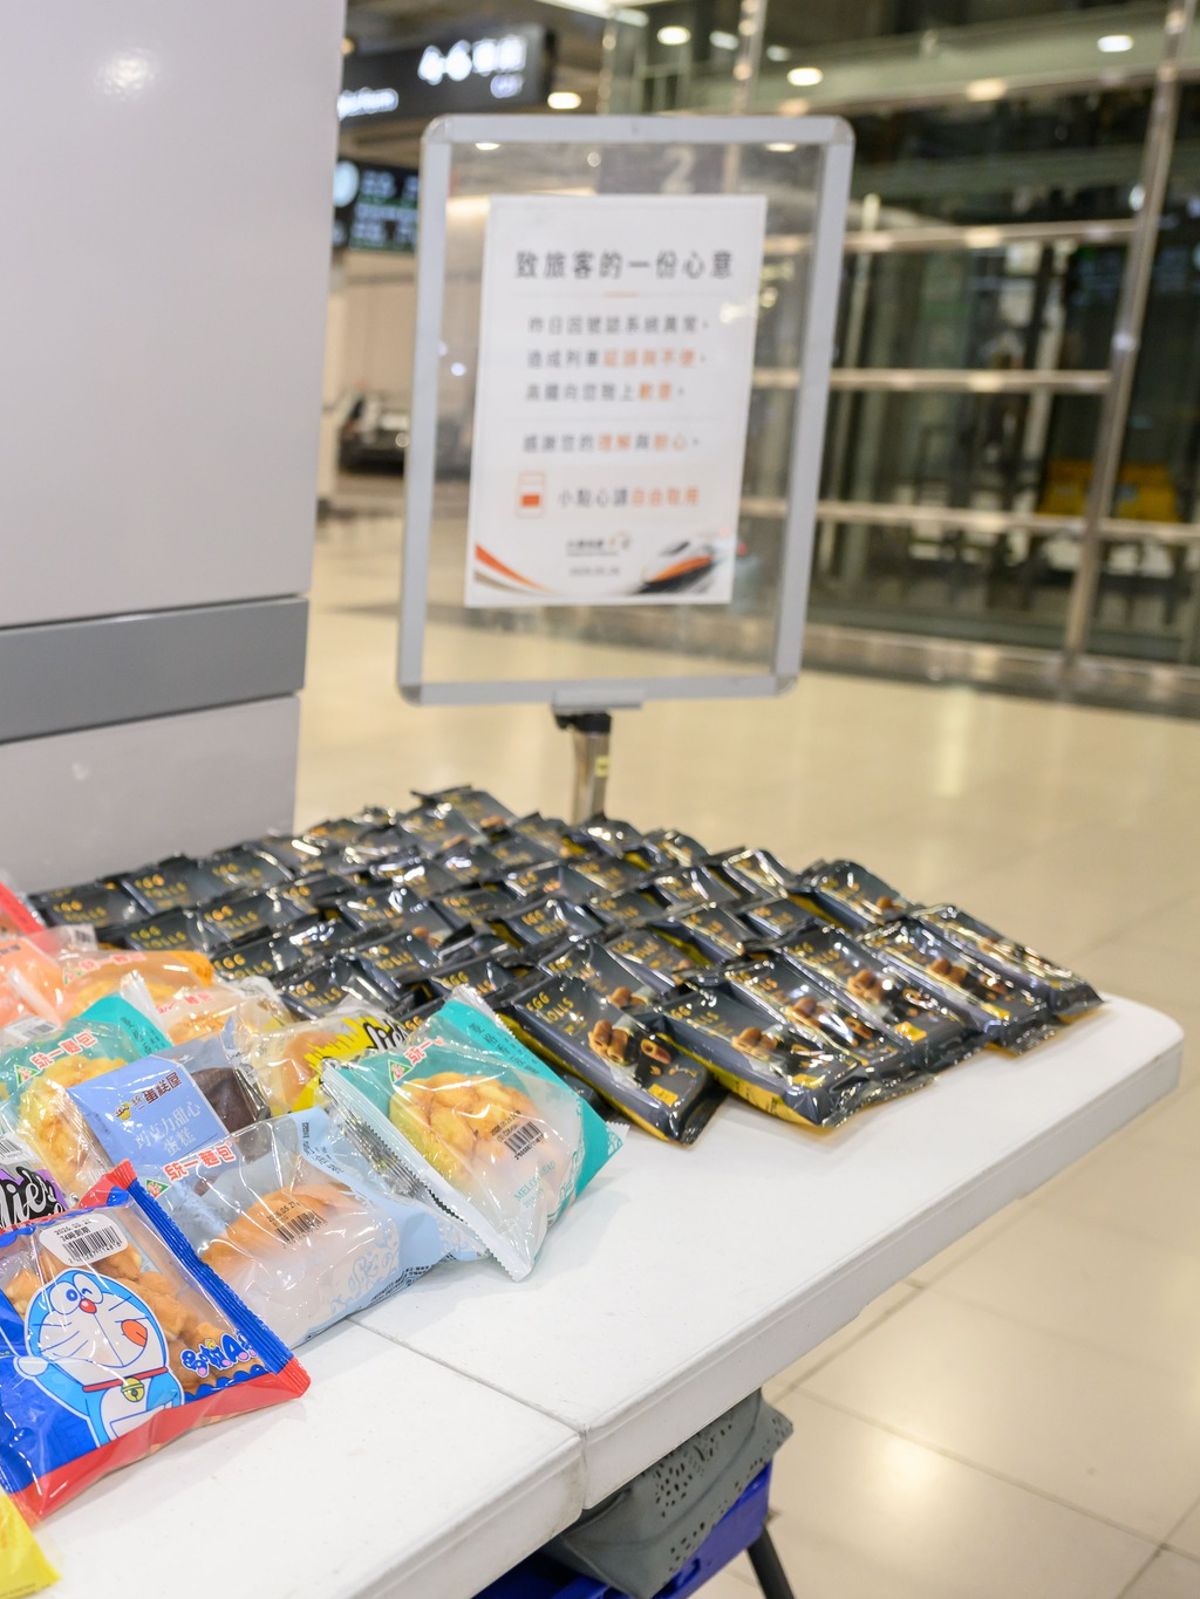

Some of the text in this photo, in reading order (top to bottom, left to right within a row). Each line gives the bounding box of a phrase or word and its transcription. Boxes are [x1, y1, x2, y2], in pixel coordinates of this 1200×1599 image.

[515, 250, 734, 279] 致旅客的一份心意
[29, 1029, 98, 1069] 統一麵包
[144, 1072, 183, 1104] 蛋糕屋
[162, 1142, 236, 1181] 統一麵包
